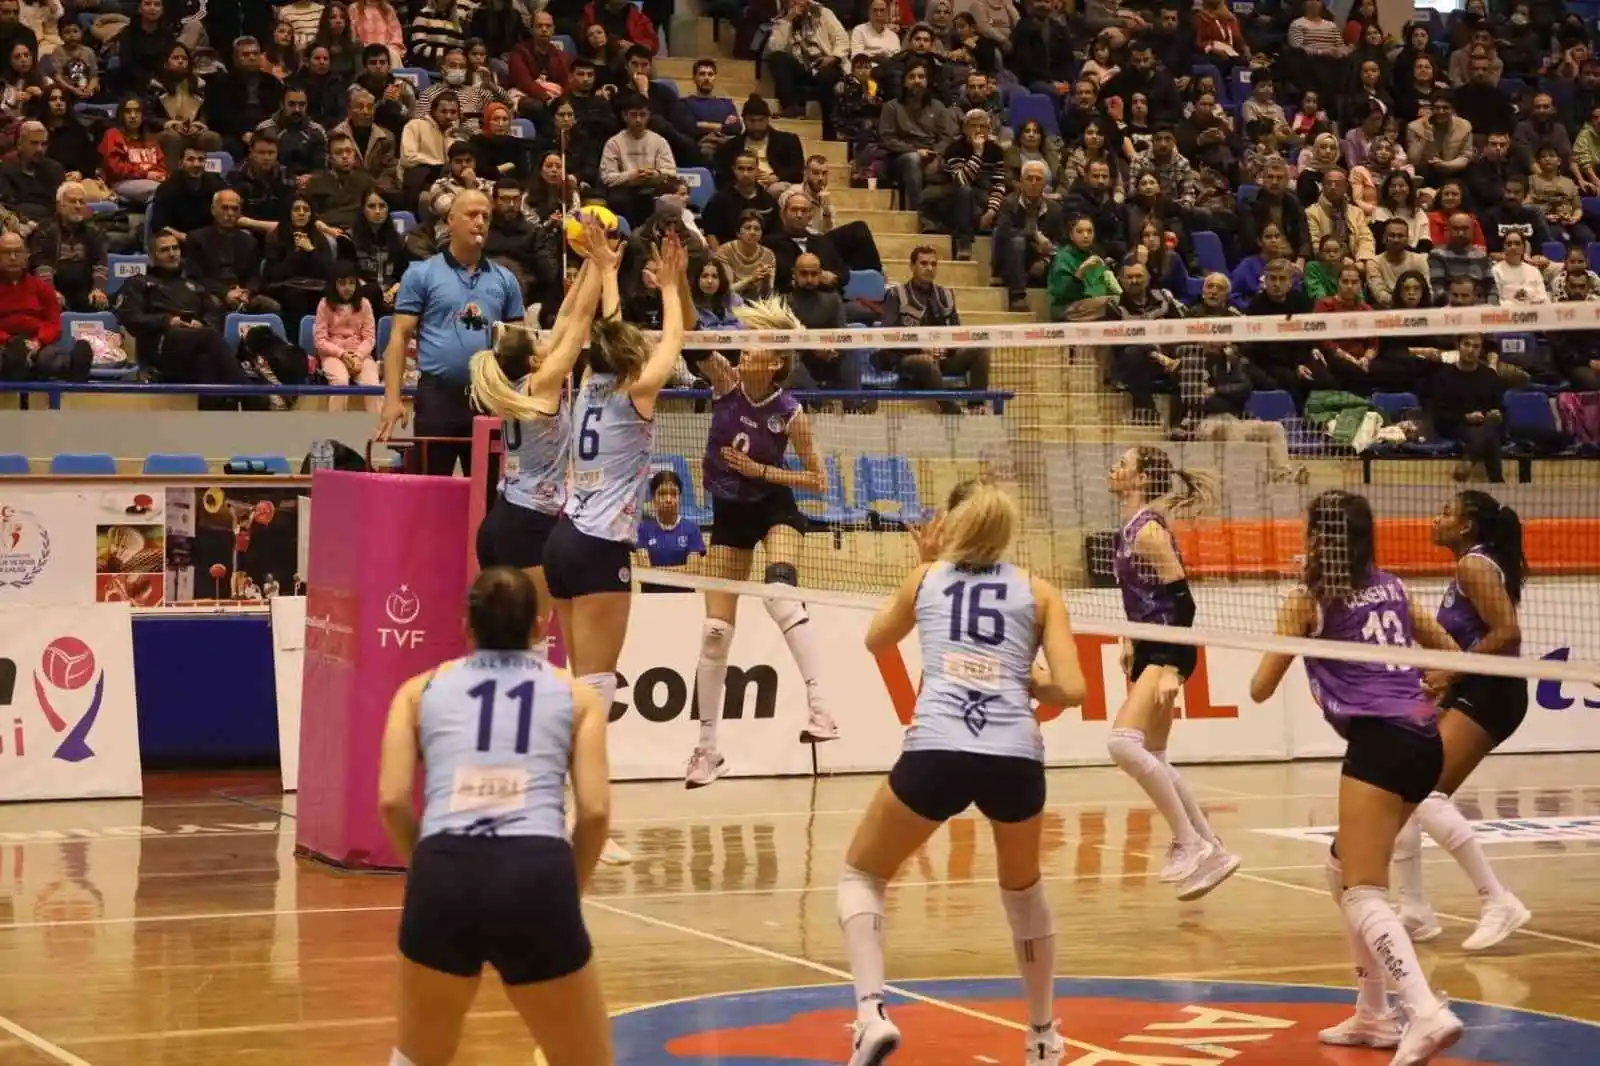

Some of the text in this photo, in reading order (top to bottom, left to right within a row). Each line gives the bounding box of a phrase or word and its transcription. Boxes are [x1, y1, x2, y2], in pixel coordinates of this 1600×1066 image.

[579, 406, 602, 461] 6
[377, 628, 425, 649] TVF
[942, 580, 1008, 646] 16
[467, 678, 535, 754] 11
